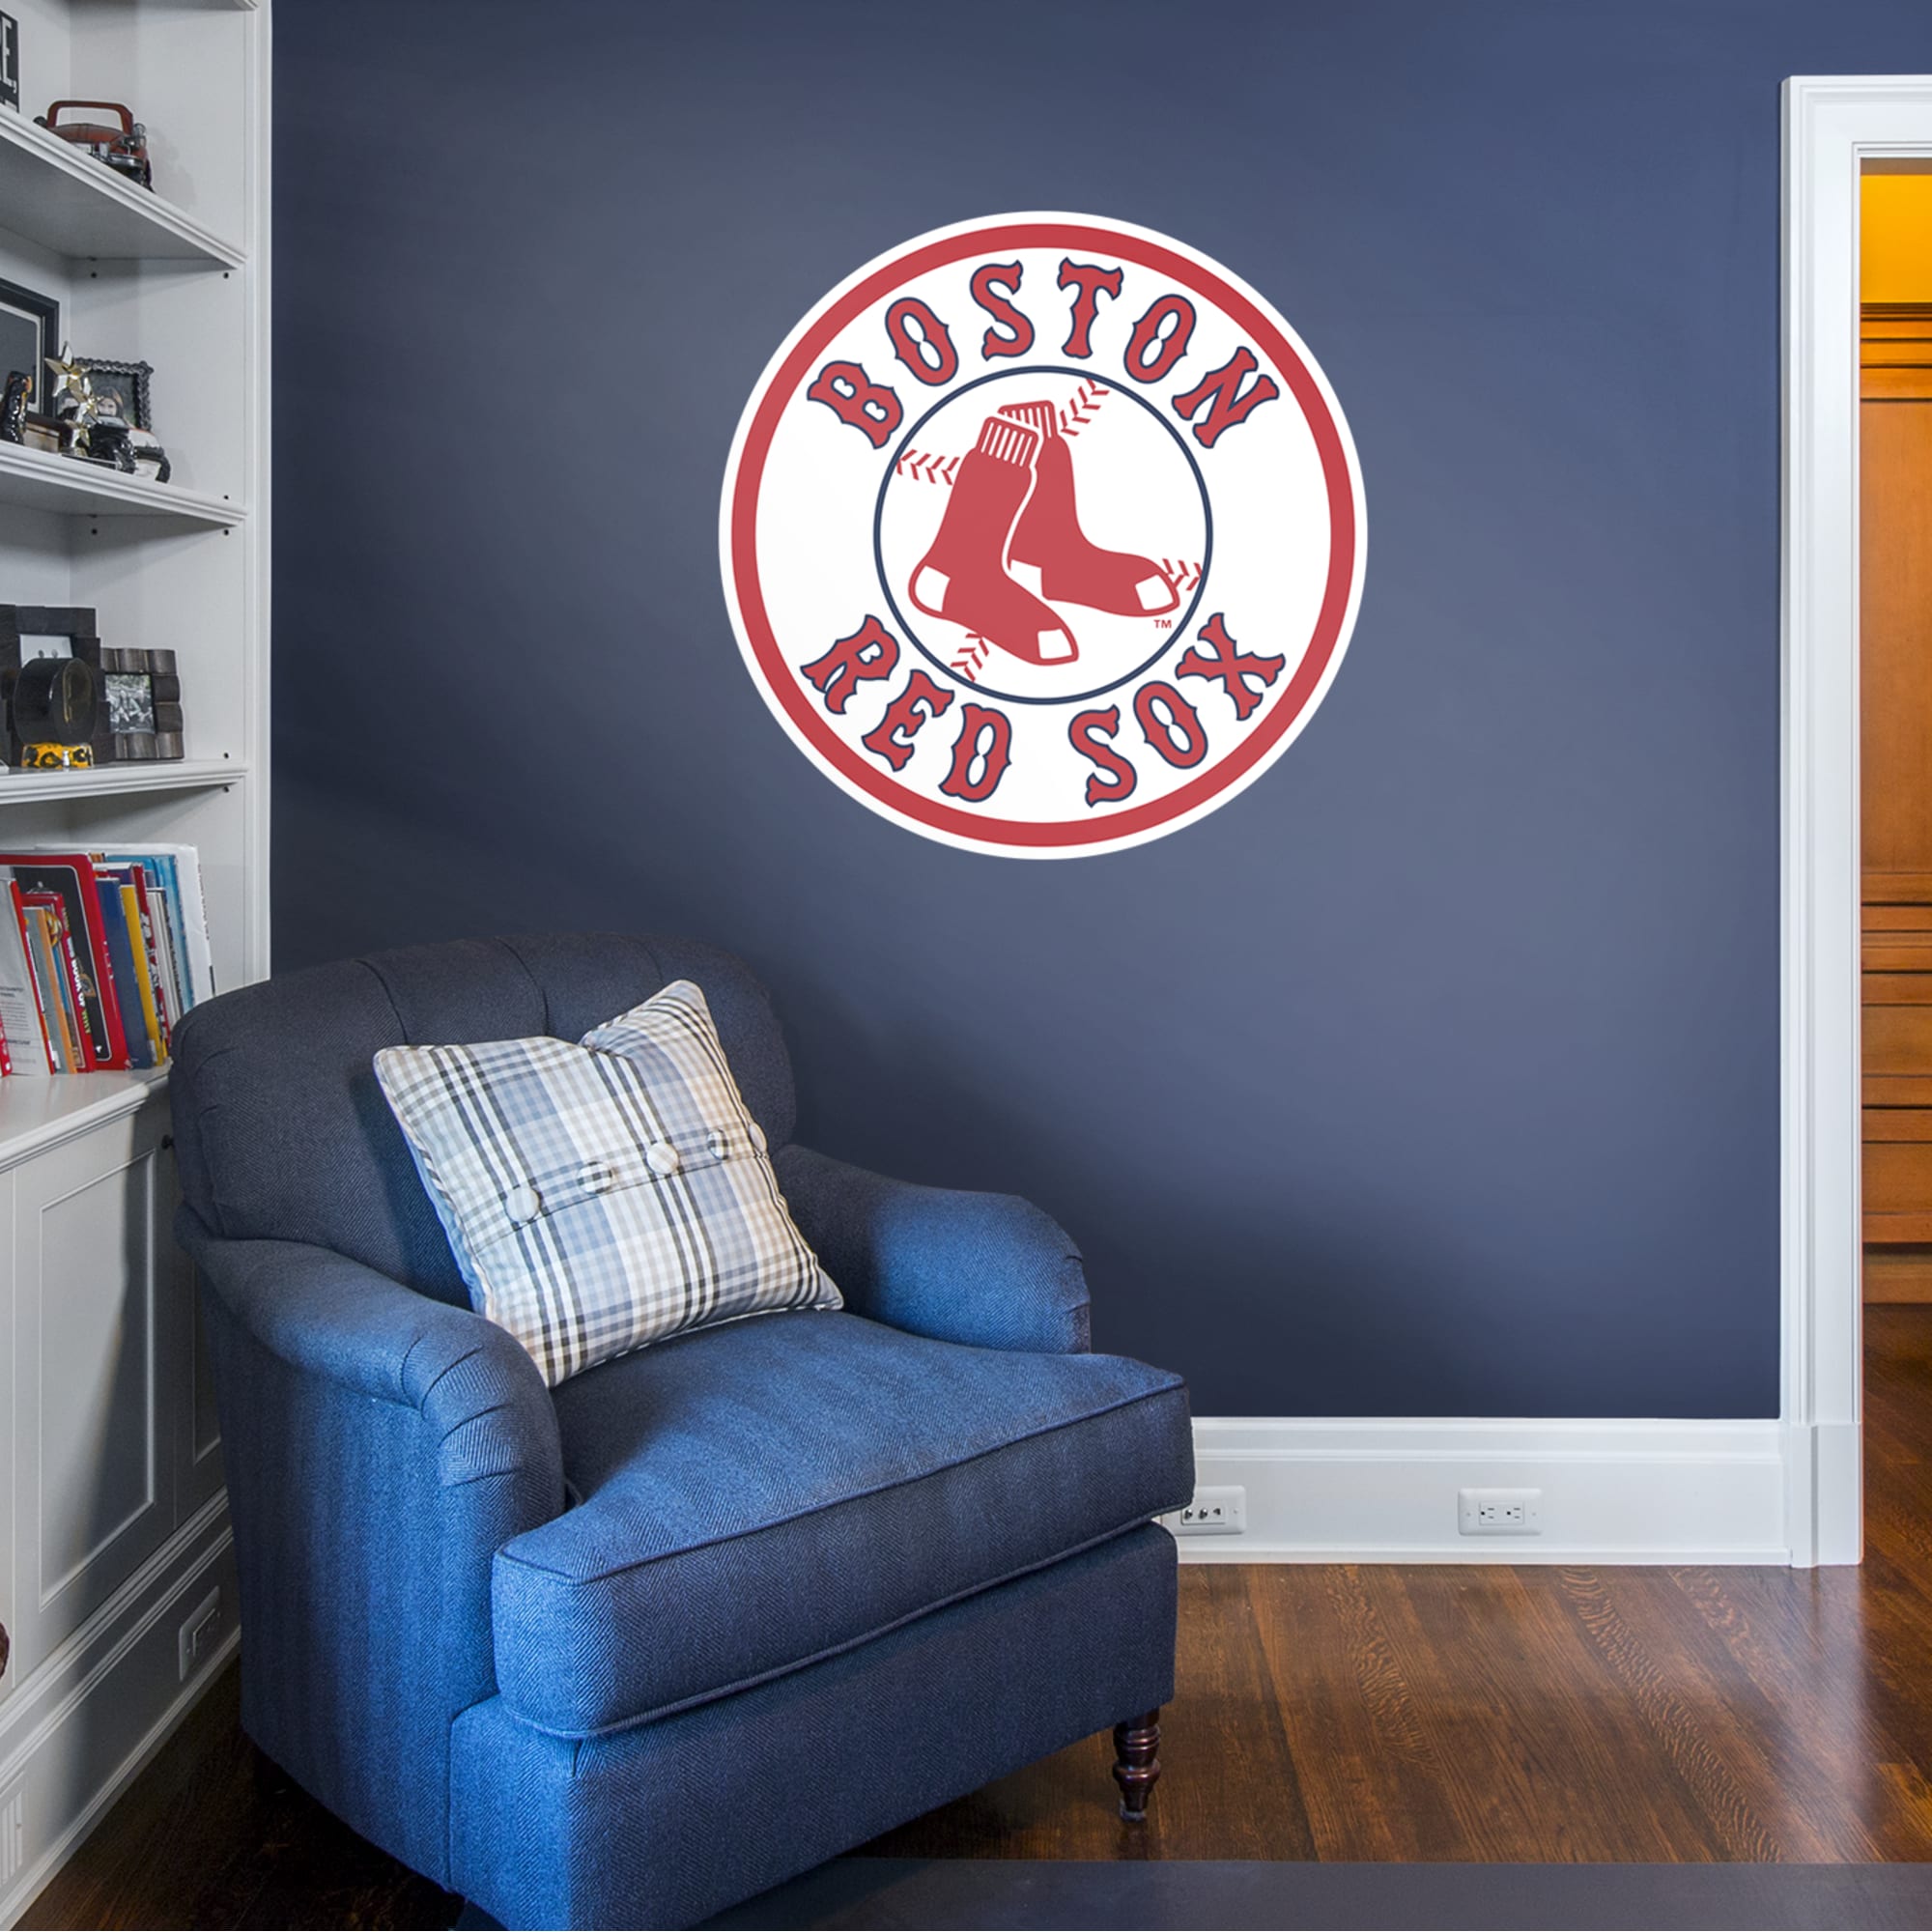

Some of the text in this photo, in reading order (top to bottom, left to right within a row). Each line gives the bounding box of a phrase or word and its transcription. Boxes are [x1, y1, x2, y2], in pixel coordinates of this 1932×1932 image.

[0, 9, 16, 94] E,
[807, 257, 1281, 450] BOSTON
[1153, 619, 1172, 629] TM
[800, 611, 1287, 809] RED SOX
